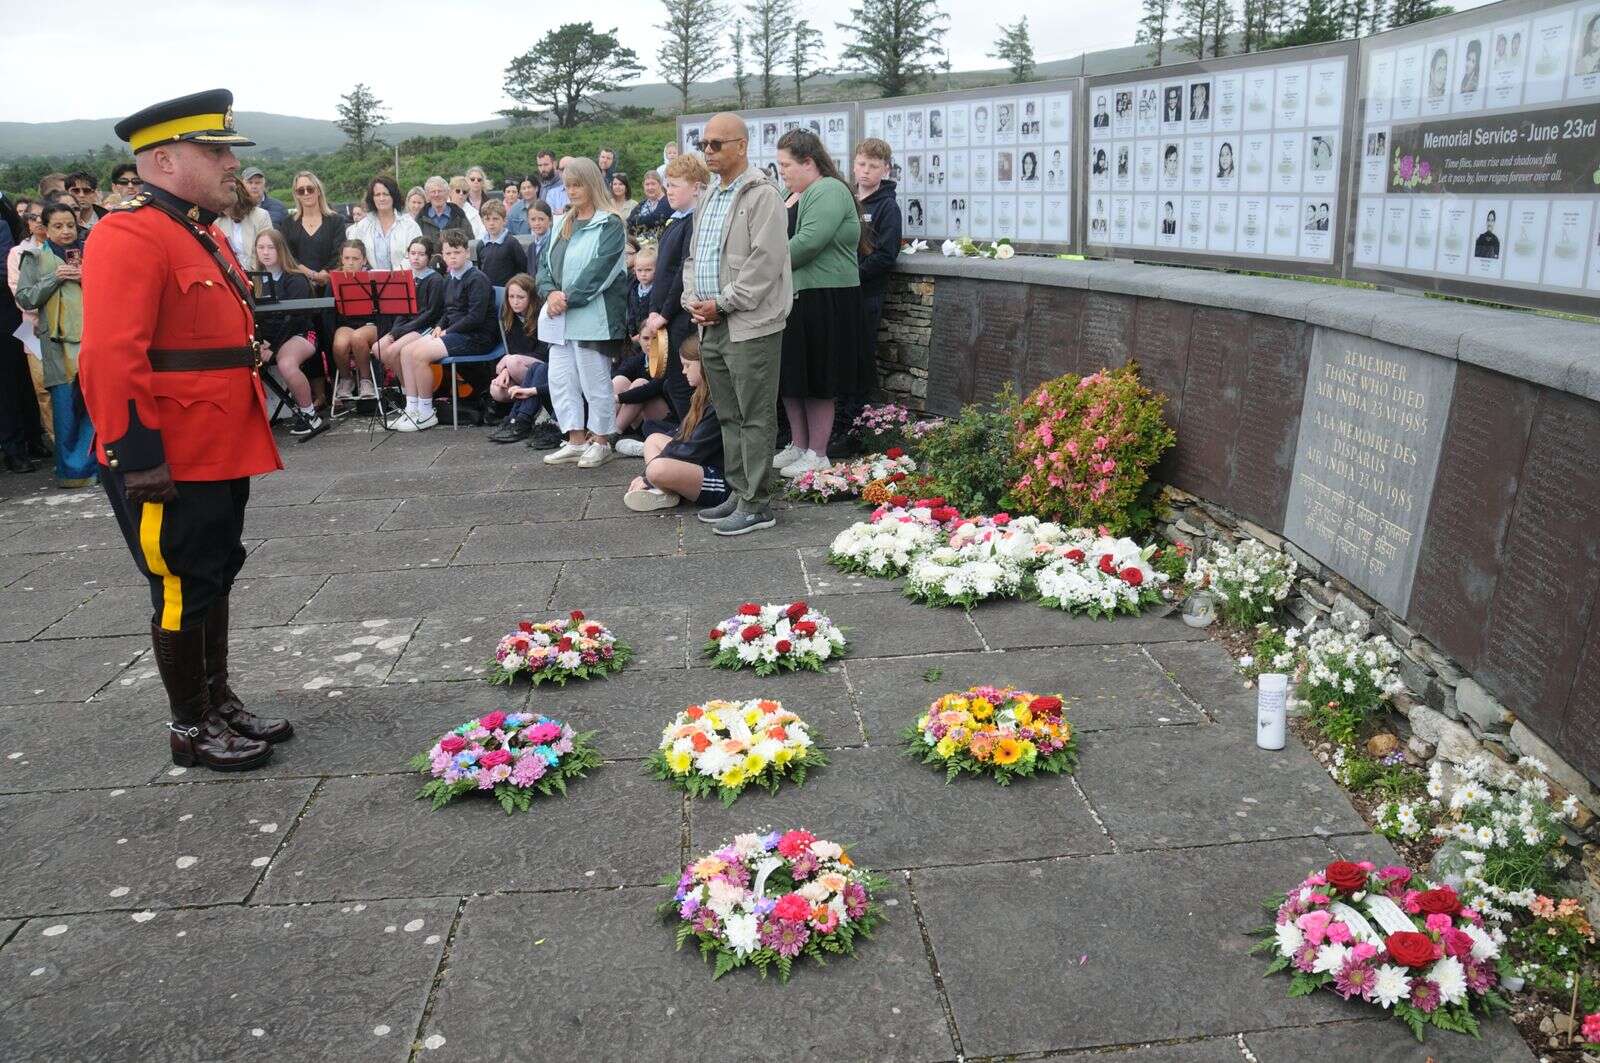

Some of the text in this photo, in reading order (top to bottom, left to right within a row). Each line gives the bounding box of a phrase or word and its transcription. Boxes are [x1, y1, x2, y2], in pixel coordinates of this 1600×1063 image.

[1423, 129, 1472, 149] Memorial
[1474, 126, 1518, 146] Service
[1527, 123, 1559, 142] June
[1562, 118, 1597, 139] 23rd
[1476, 172, 1488, 182] love
[1489, 172, 1508, 185] reigns
[1508, 171, 1534, 184] forever
[1534, 173, 1551, 182] over
[1488, 157, 1499, 167] rise
[1500, 155, 1513, 166] and
[1514, 154, 1543, 166] shadows
[1344, 350, 1408, 382] REMEMBER
[1325, 363, 1424, 409] THOSE WHO DIED
[1315, 381, 1332, 400] AIR
[1335, 387, 1367, 412] INDIA
[1369, 400, 1382, 418] 23
[1400, 408, 1428, 435] 1985
[1323, 413, 1334, 431] LA
[1337, 420, 1390, 454] MEMOIRE
[1393, 442, 1417, 466] DES
[1333, 438, 1385, 474] DISPARUS
[1306, 446, 1412, 512] AIR INDIA 23 VI 1985
